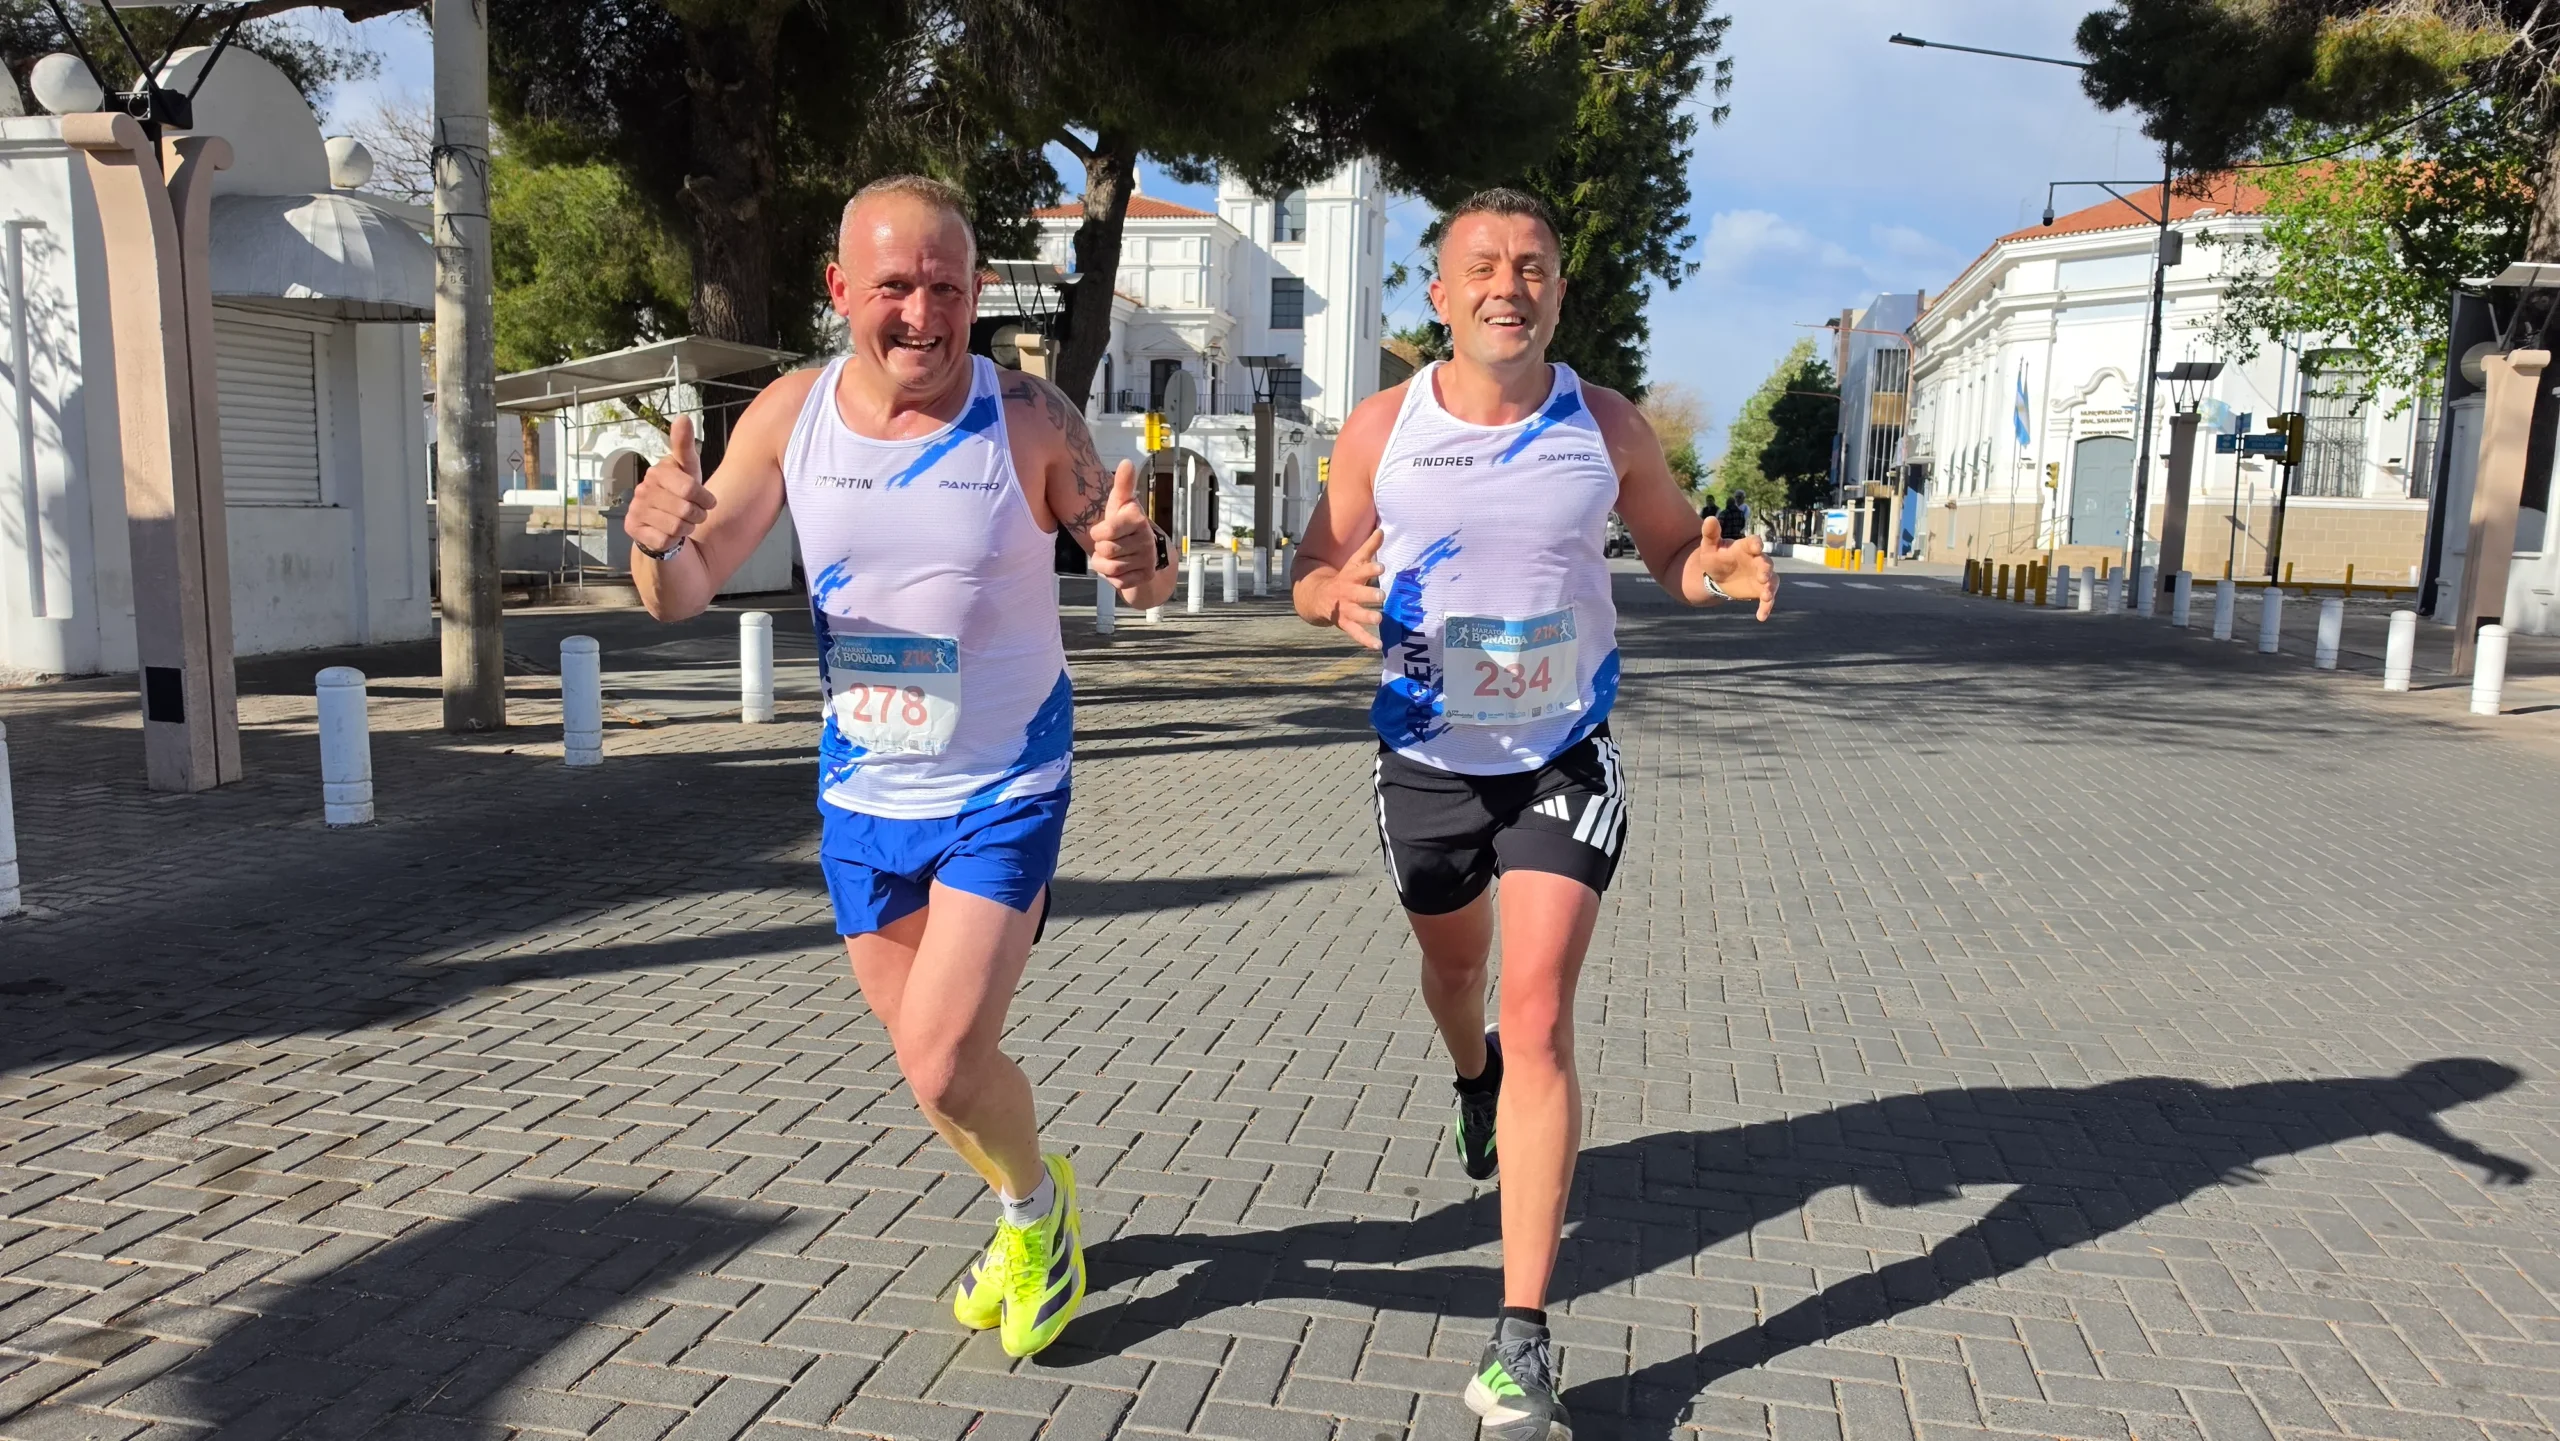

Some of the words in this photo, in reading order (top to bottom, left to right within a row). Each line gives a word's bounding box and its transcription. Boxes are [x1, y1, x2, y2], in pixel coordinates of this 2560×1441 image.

[1413, 456, 1474, 467] ANDRES
[1538, 453, 1591, 462] PANTRO
[815, 475, 873, 490] MARTIN
[938, 480, 1000, 491] PANTRO
[1472, 633, 1528, 646] BONARDA
[843, 652, 896, 665] BONARDA
[1473, 656, 1552, 699] 234
[850, 682, 928, 726] 278
